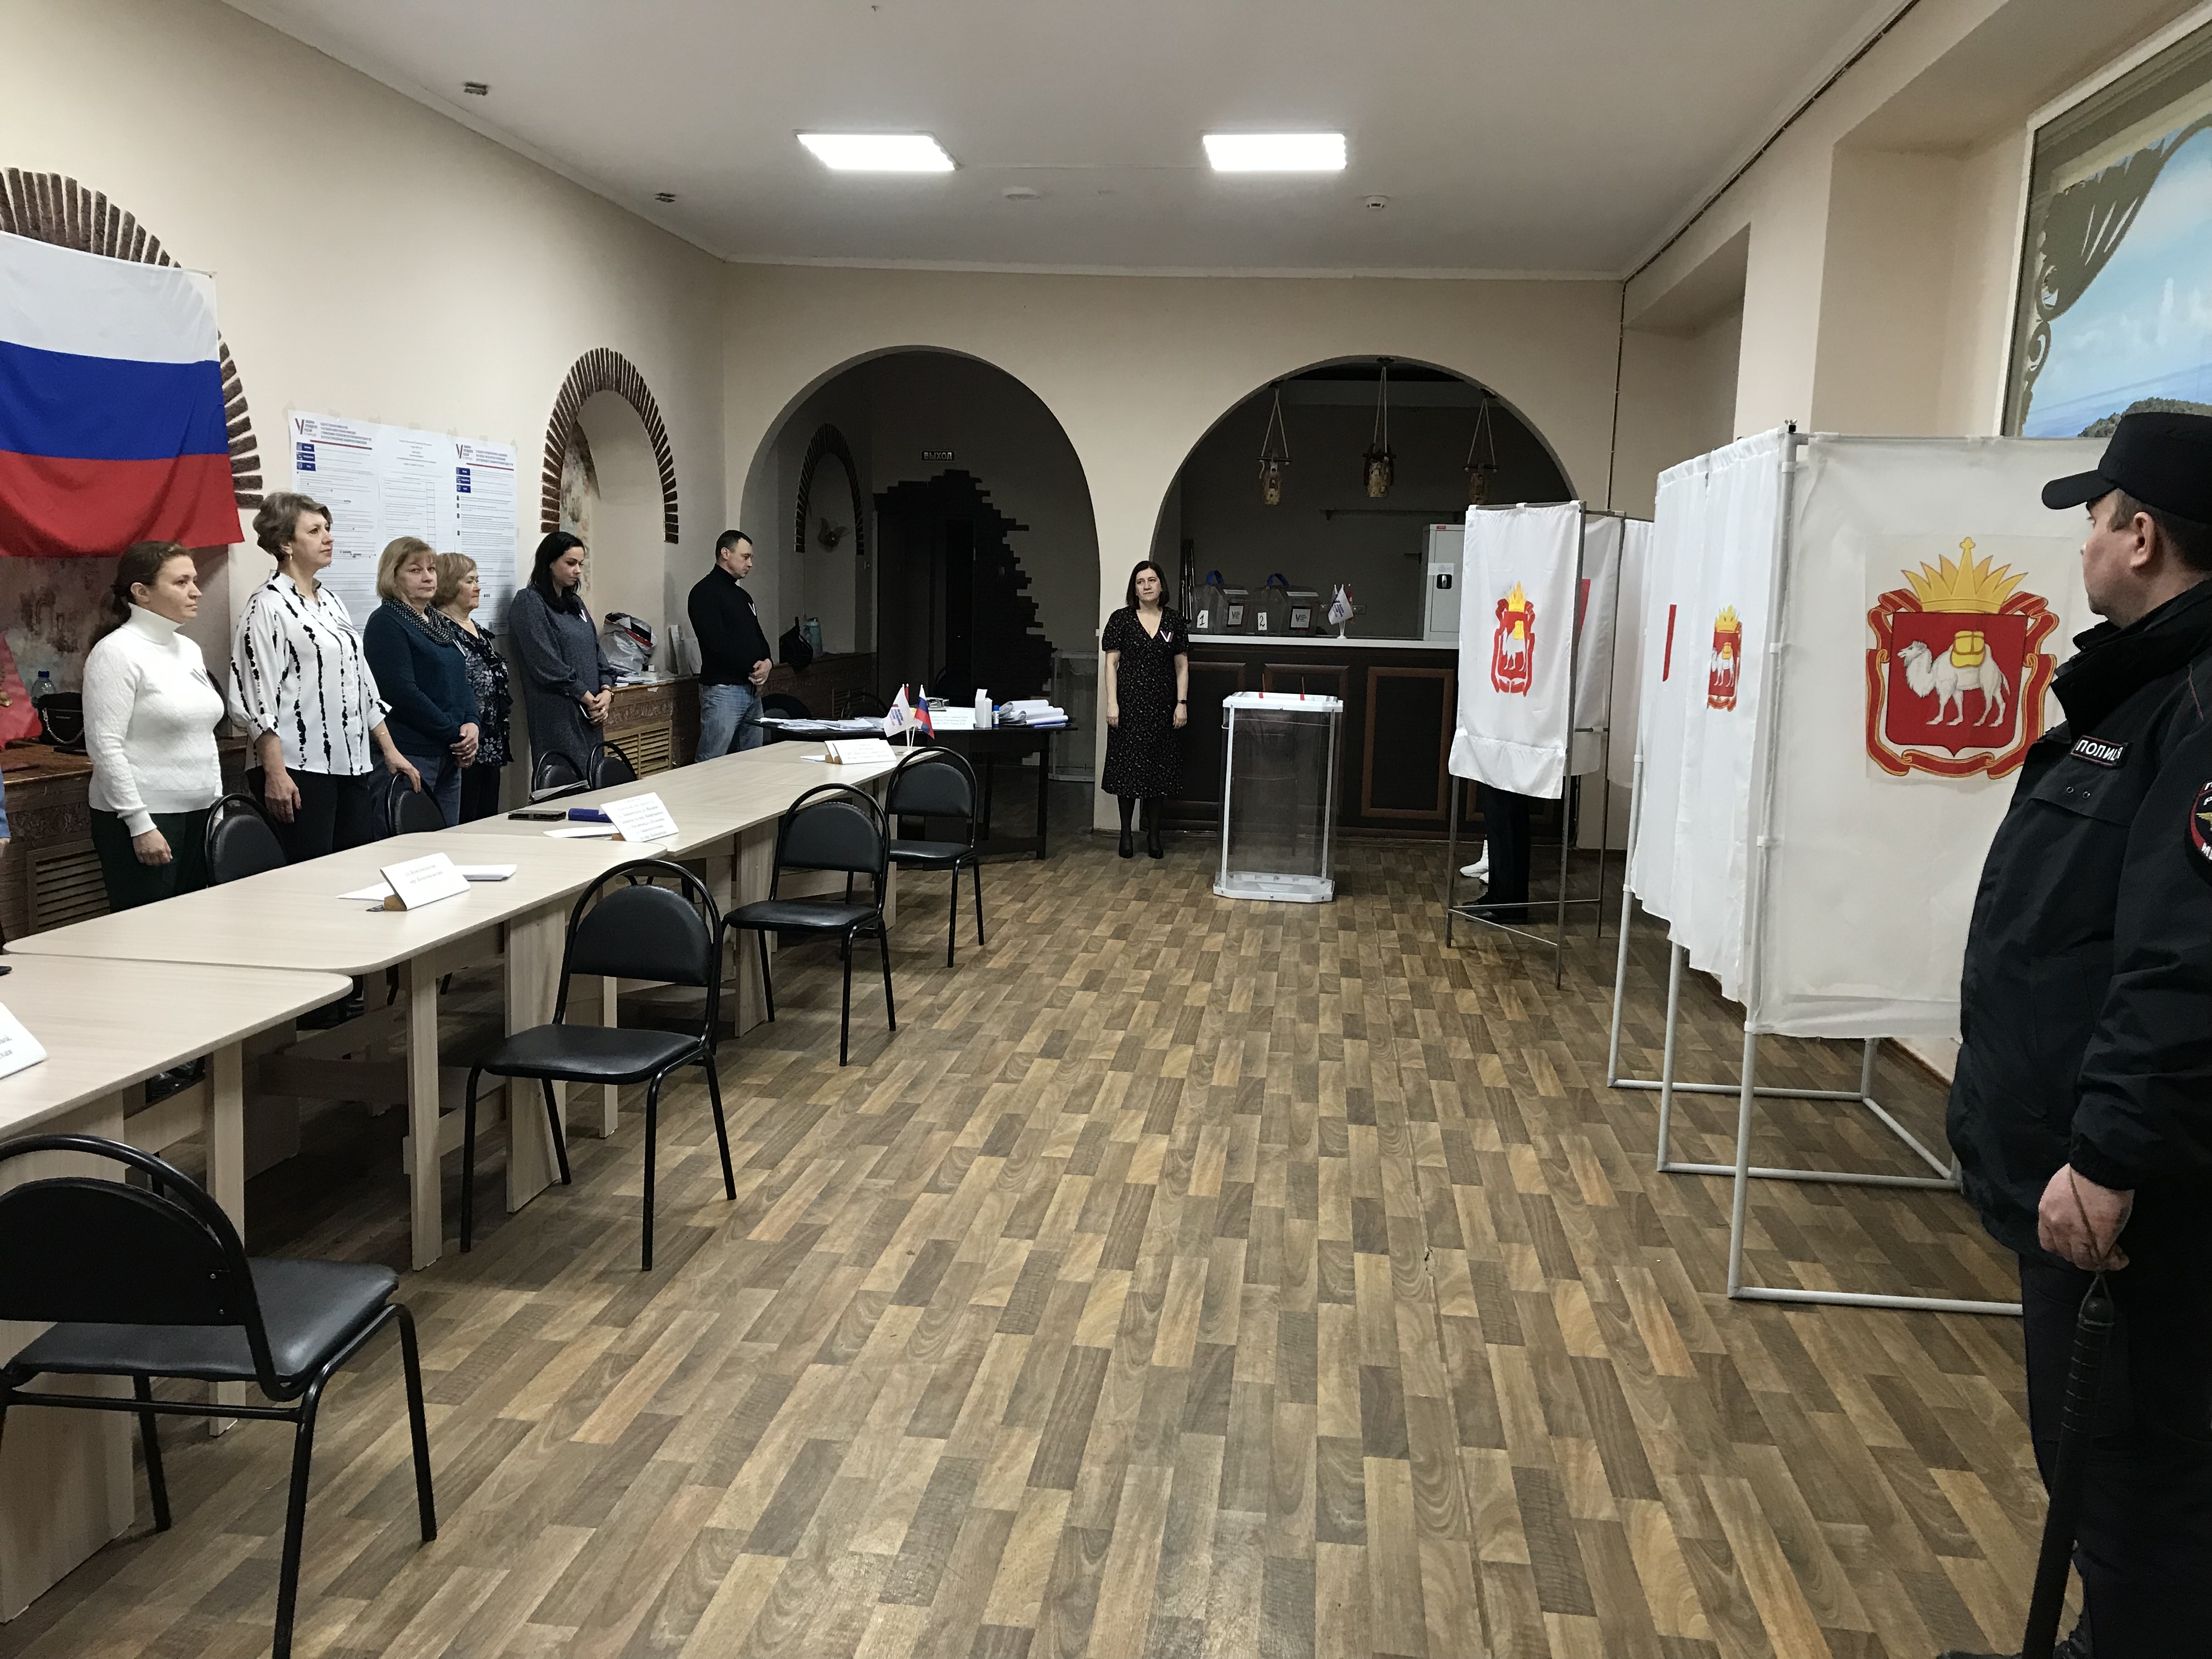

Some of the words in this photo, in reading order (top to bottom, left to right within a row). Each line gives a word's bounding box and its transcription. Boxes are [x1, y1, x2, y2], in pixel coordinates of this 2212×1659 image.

[924, 452, 952, 460] ВЫХОД
[1199, 614, 1205, 626] 1
[1259, 615, 1265, 627] 2
